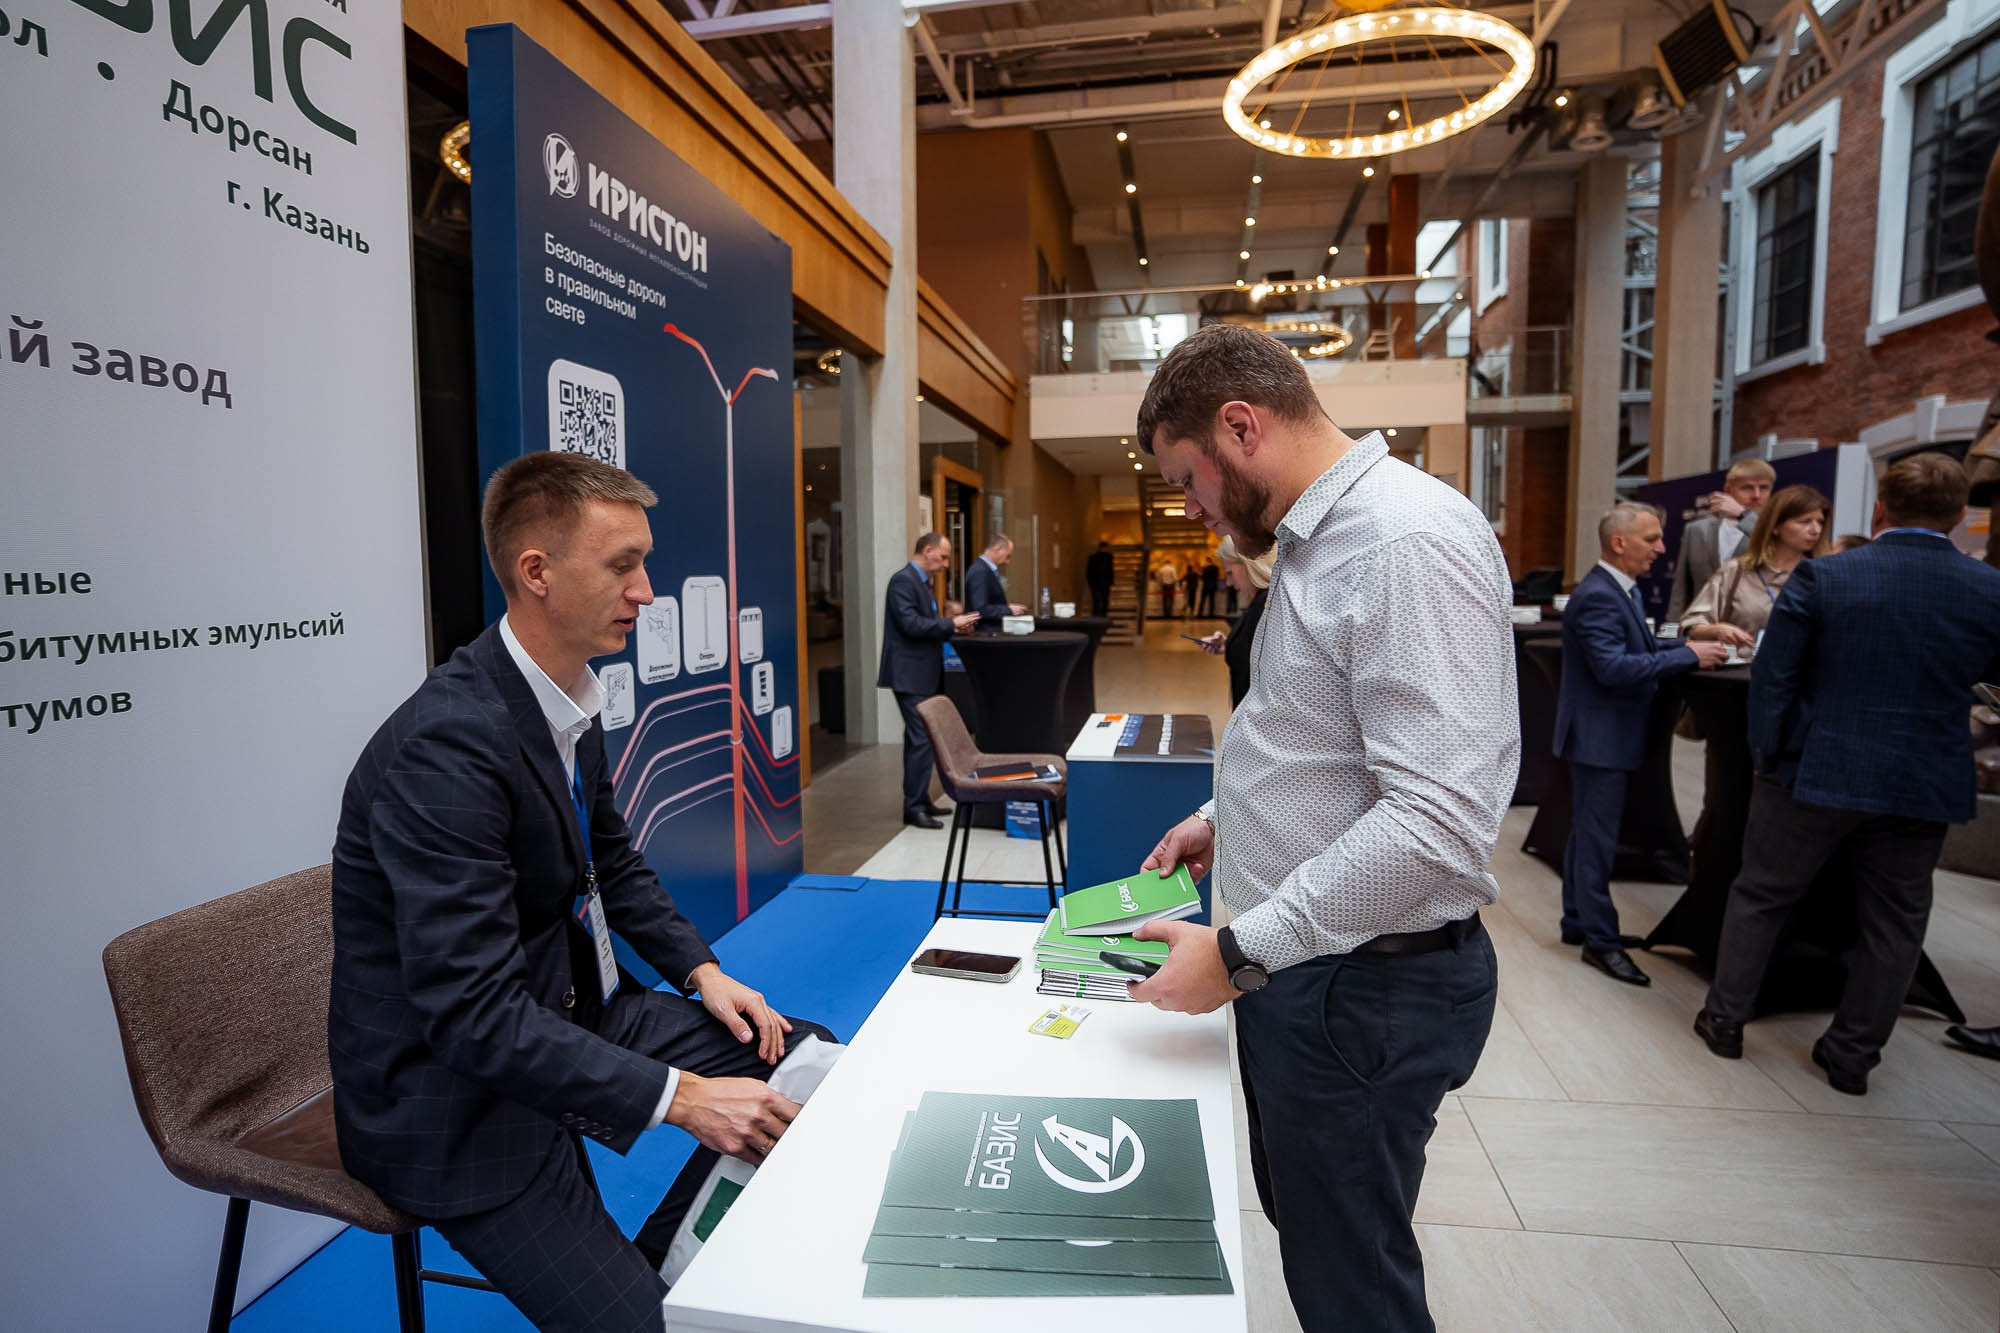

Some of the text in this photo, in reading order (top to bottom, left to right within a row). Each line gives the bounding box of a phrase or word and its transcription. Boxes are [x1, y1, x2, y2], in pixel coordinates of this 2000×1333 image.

[162, 78, 313, 176] Дорсан
[226, 180, 371, 255] г. Казань
[587, 161, 708, 274] ИРИСТОН
[544, 231, 627, 290] Безопасные
[627, 278, 667, 309] дороги
[544, 266, 637, 320] в правильном
[545, 296, 586, 325] свете
[71, 340, 233, 410] завод
[0, 611, 344, 665] битумных эмульсий
[978, 1111, 1022, 1190] БАЗИС
